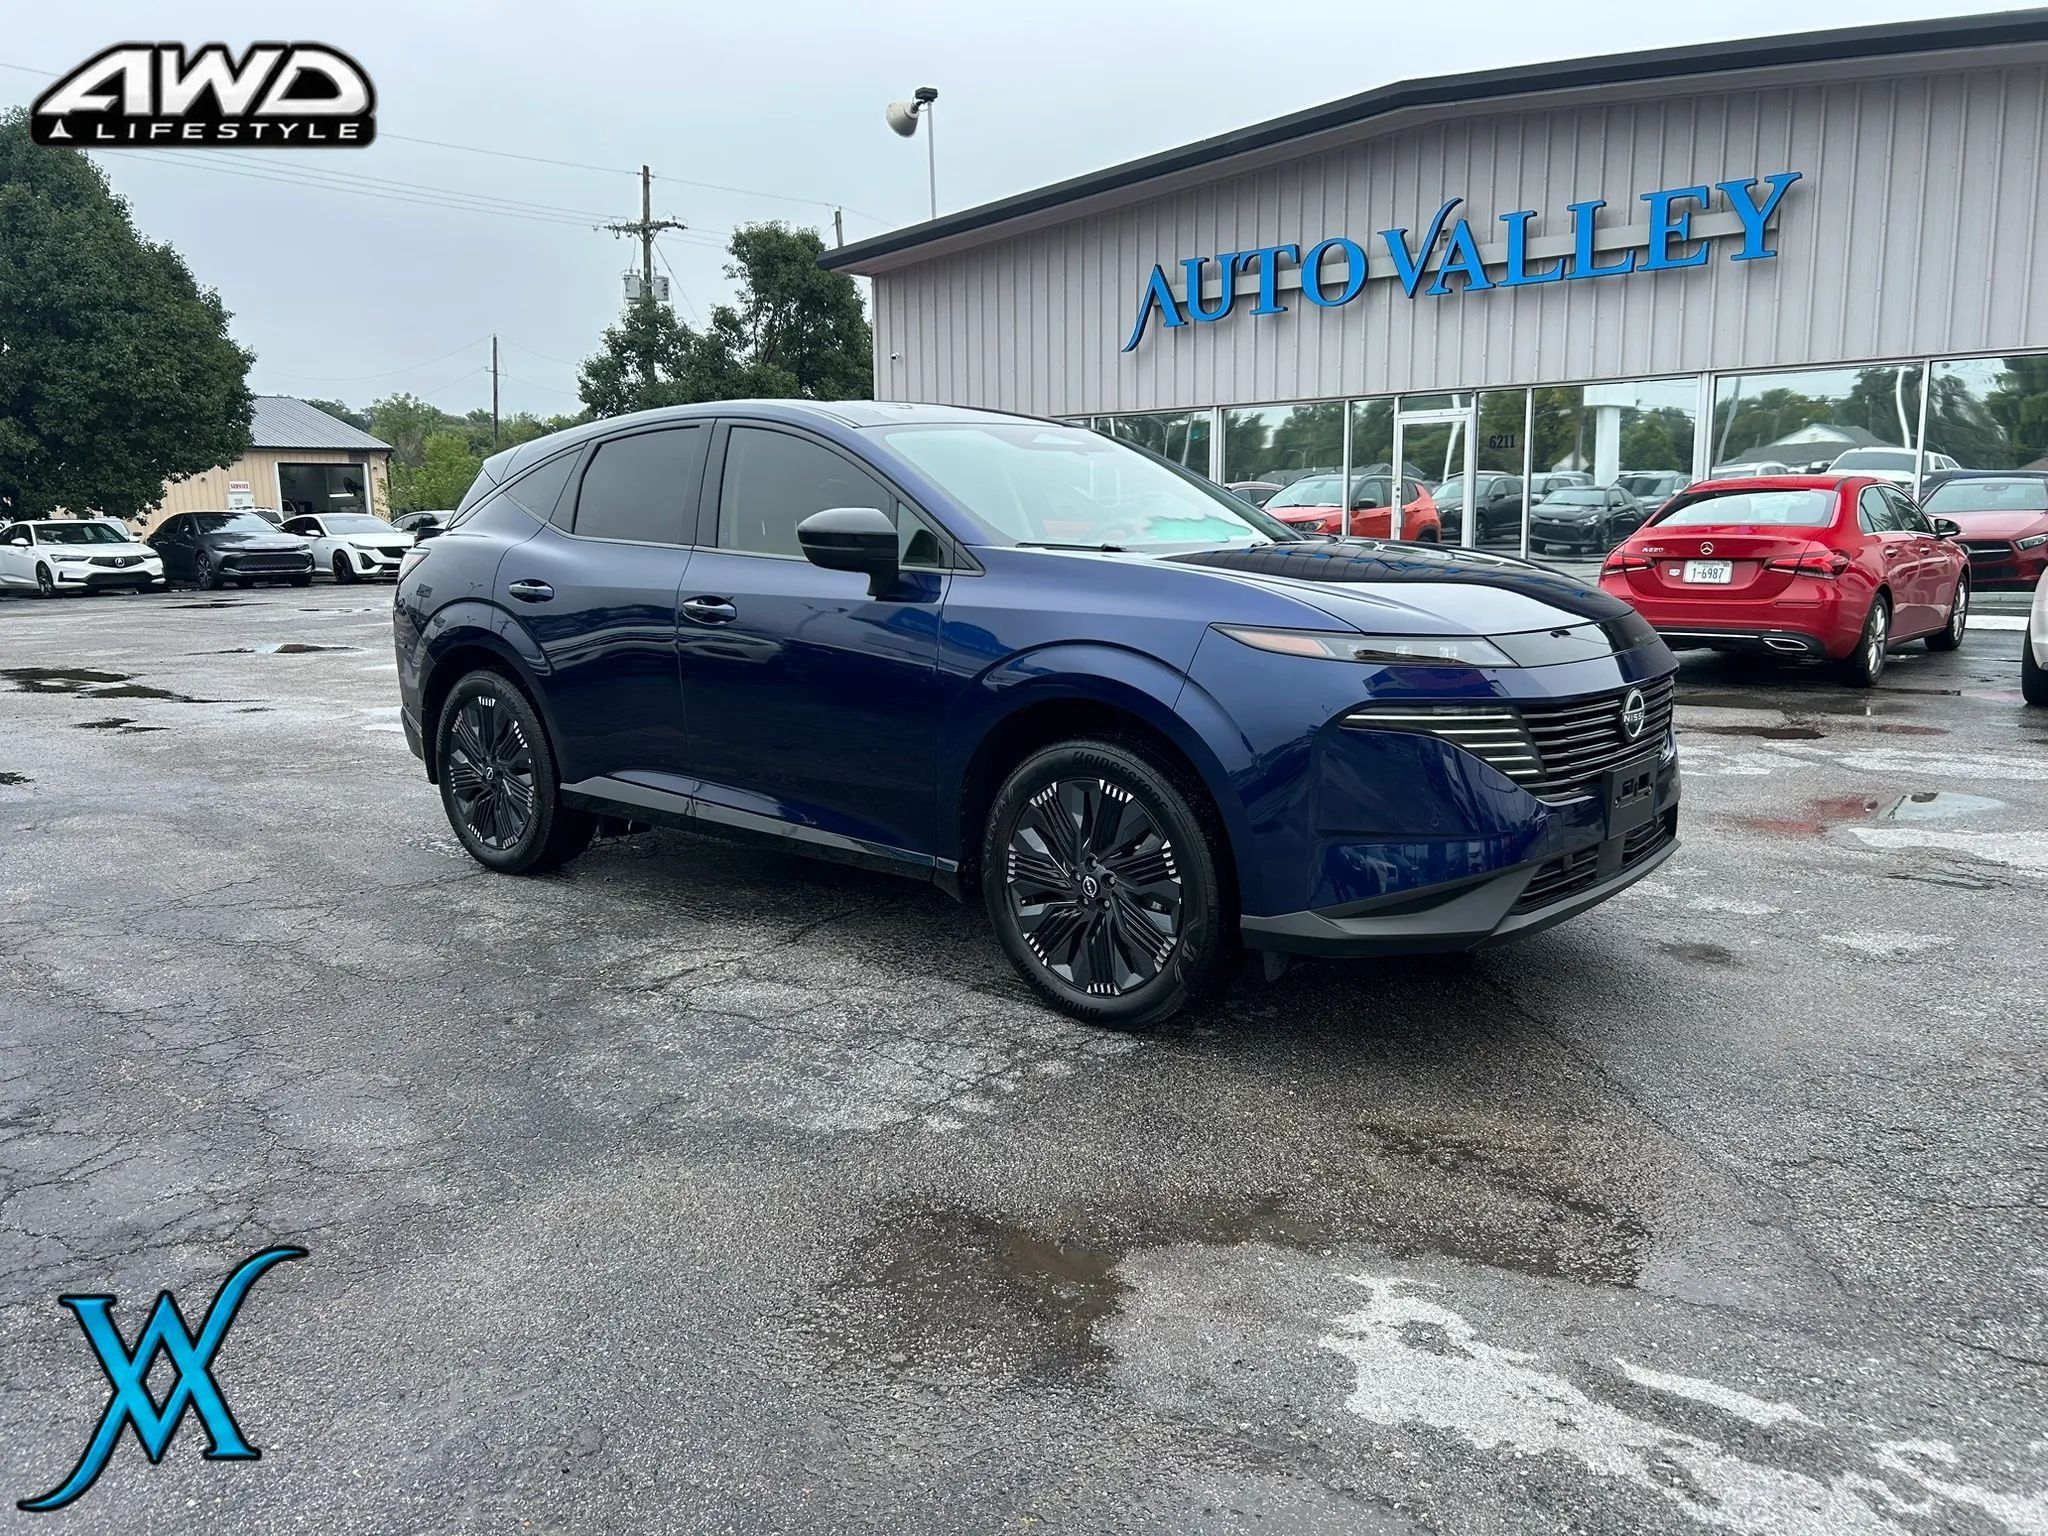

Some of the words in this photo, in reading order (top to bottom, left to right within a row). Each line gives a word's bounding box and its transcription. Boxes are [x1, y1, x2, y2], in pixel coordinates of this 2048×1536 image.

[1121, 237, 1369, 352] AUTO
[1377, 171, 1802, 299] VALLEY
[1490, 434, 1515, 449] 6211
[1692, 567, 1724, 580] 1-6987
[1072, 751, 1169, 811] BRIDGESTONE
